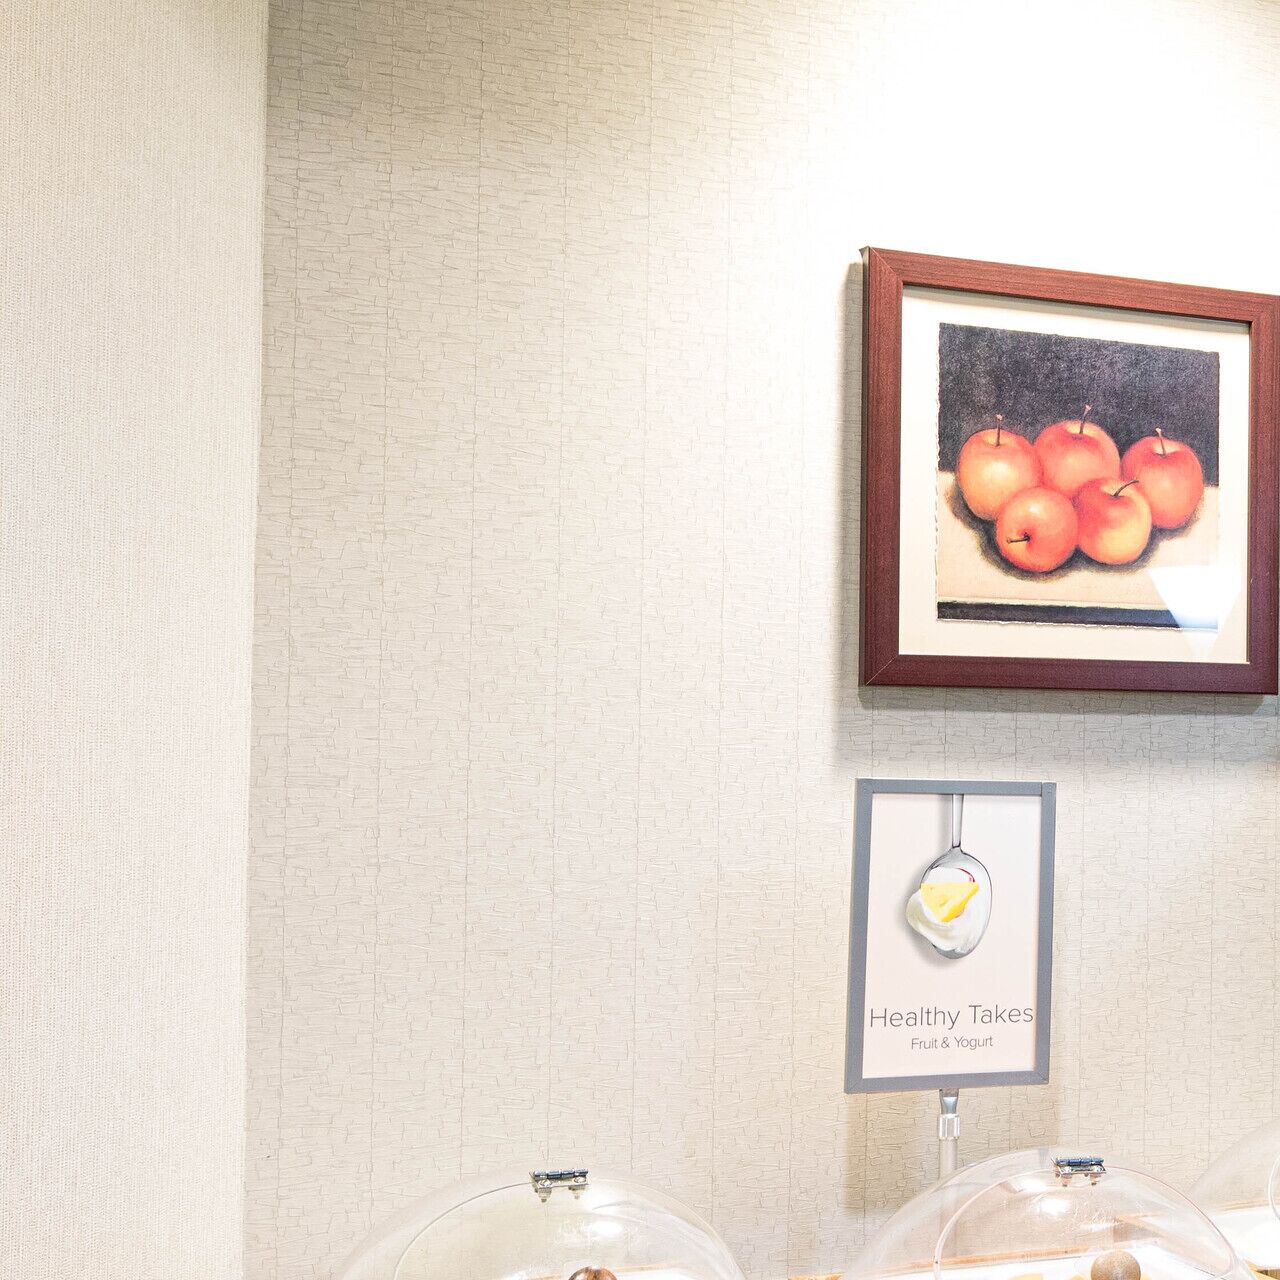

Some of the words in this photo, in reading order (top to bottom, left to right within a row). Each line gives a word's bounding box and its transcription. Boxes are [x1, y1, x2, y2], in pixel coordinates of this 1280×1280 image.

[870, 1006, 960, 1030] Healthy
[968, 1004, 1034, 1025] Takes
[911, 1037, 938, 1050] Fruit
[941, 1037, 950, 1049] &
[954, 1035, 993, 1050] Yogurt
